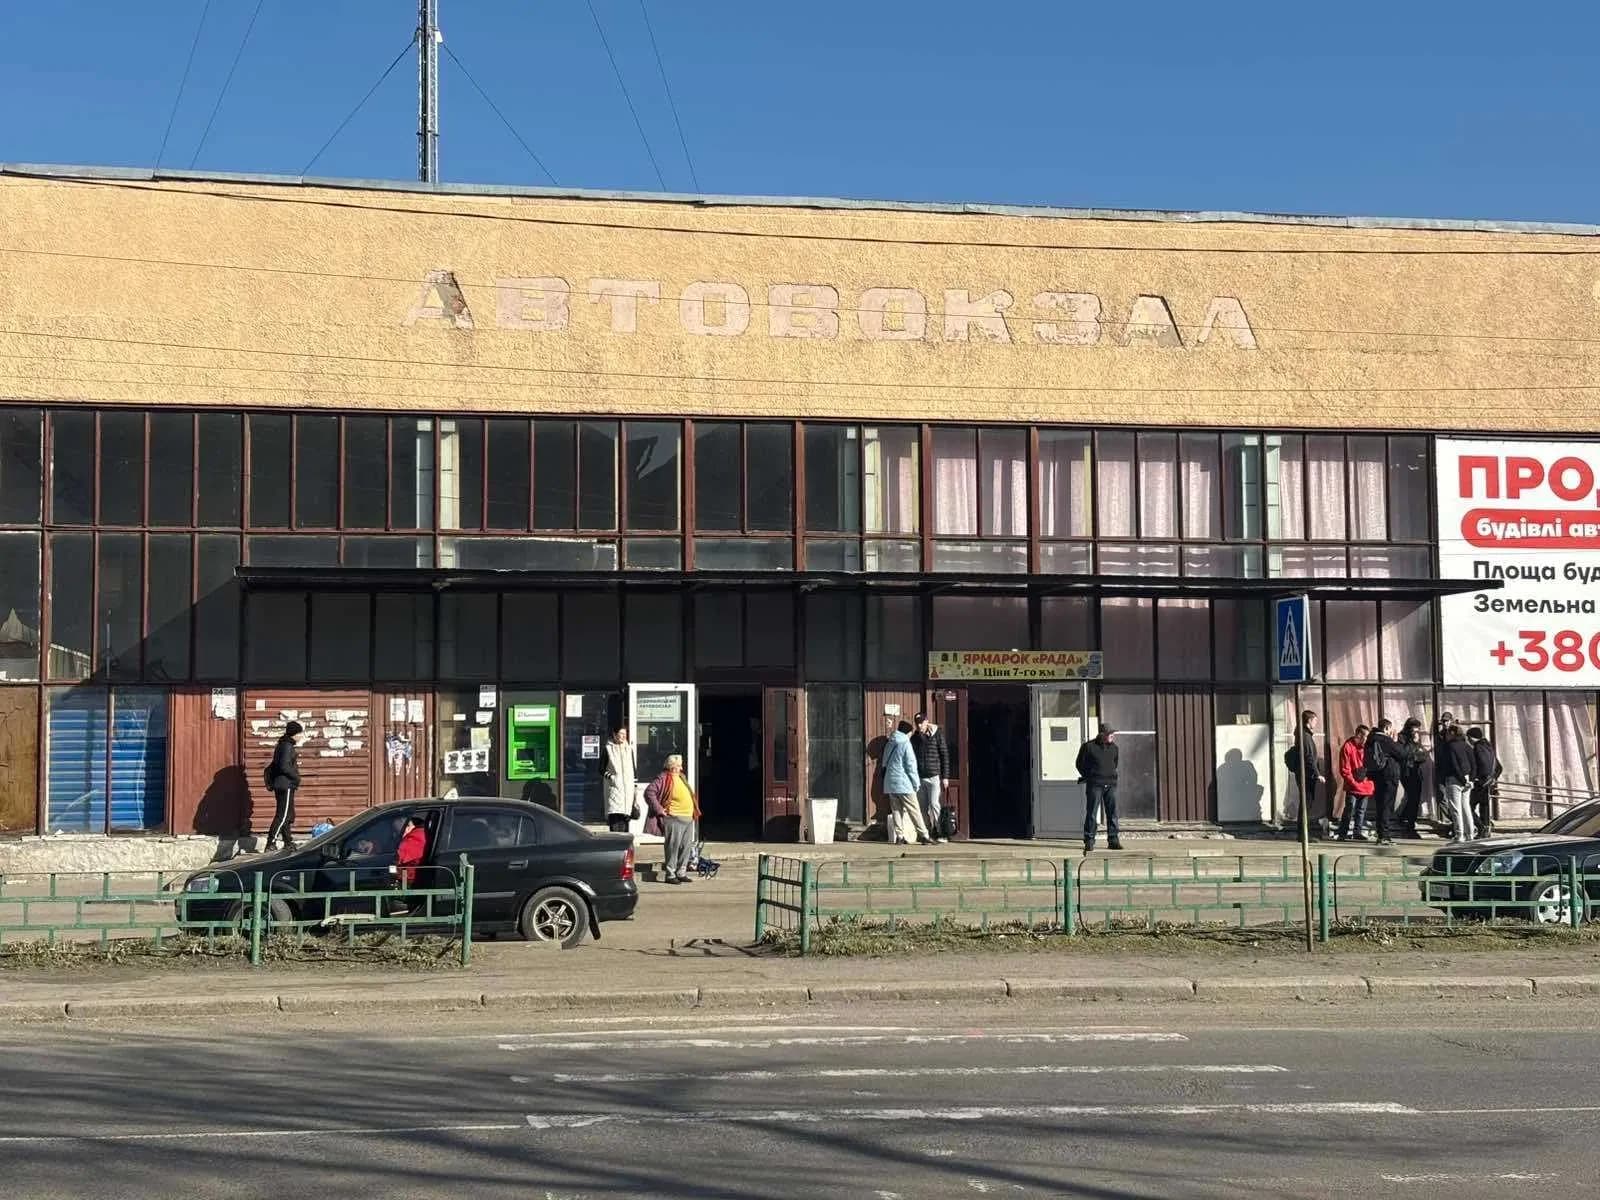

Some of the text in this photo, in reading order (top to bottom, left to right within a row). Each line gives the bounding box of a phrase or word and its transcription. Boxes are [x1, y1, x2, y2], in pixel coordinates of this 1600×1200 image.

[400, 269, 1260, 350] АВТОВОКЗАЛ
[1458, 455, 1600, 508] ПРО
[1476, 517, 1600, 540] будівлі ав
[1473, 561, 1555, 582] Площа
[1473, 594, 1595, 614] Земельна
[963, 653, 1083, 667] ЯРМАРОК «РАДА»
